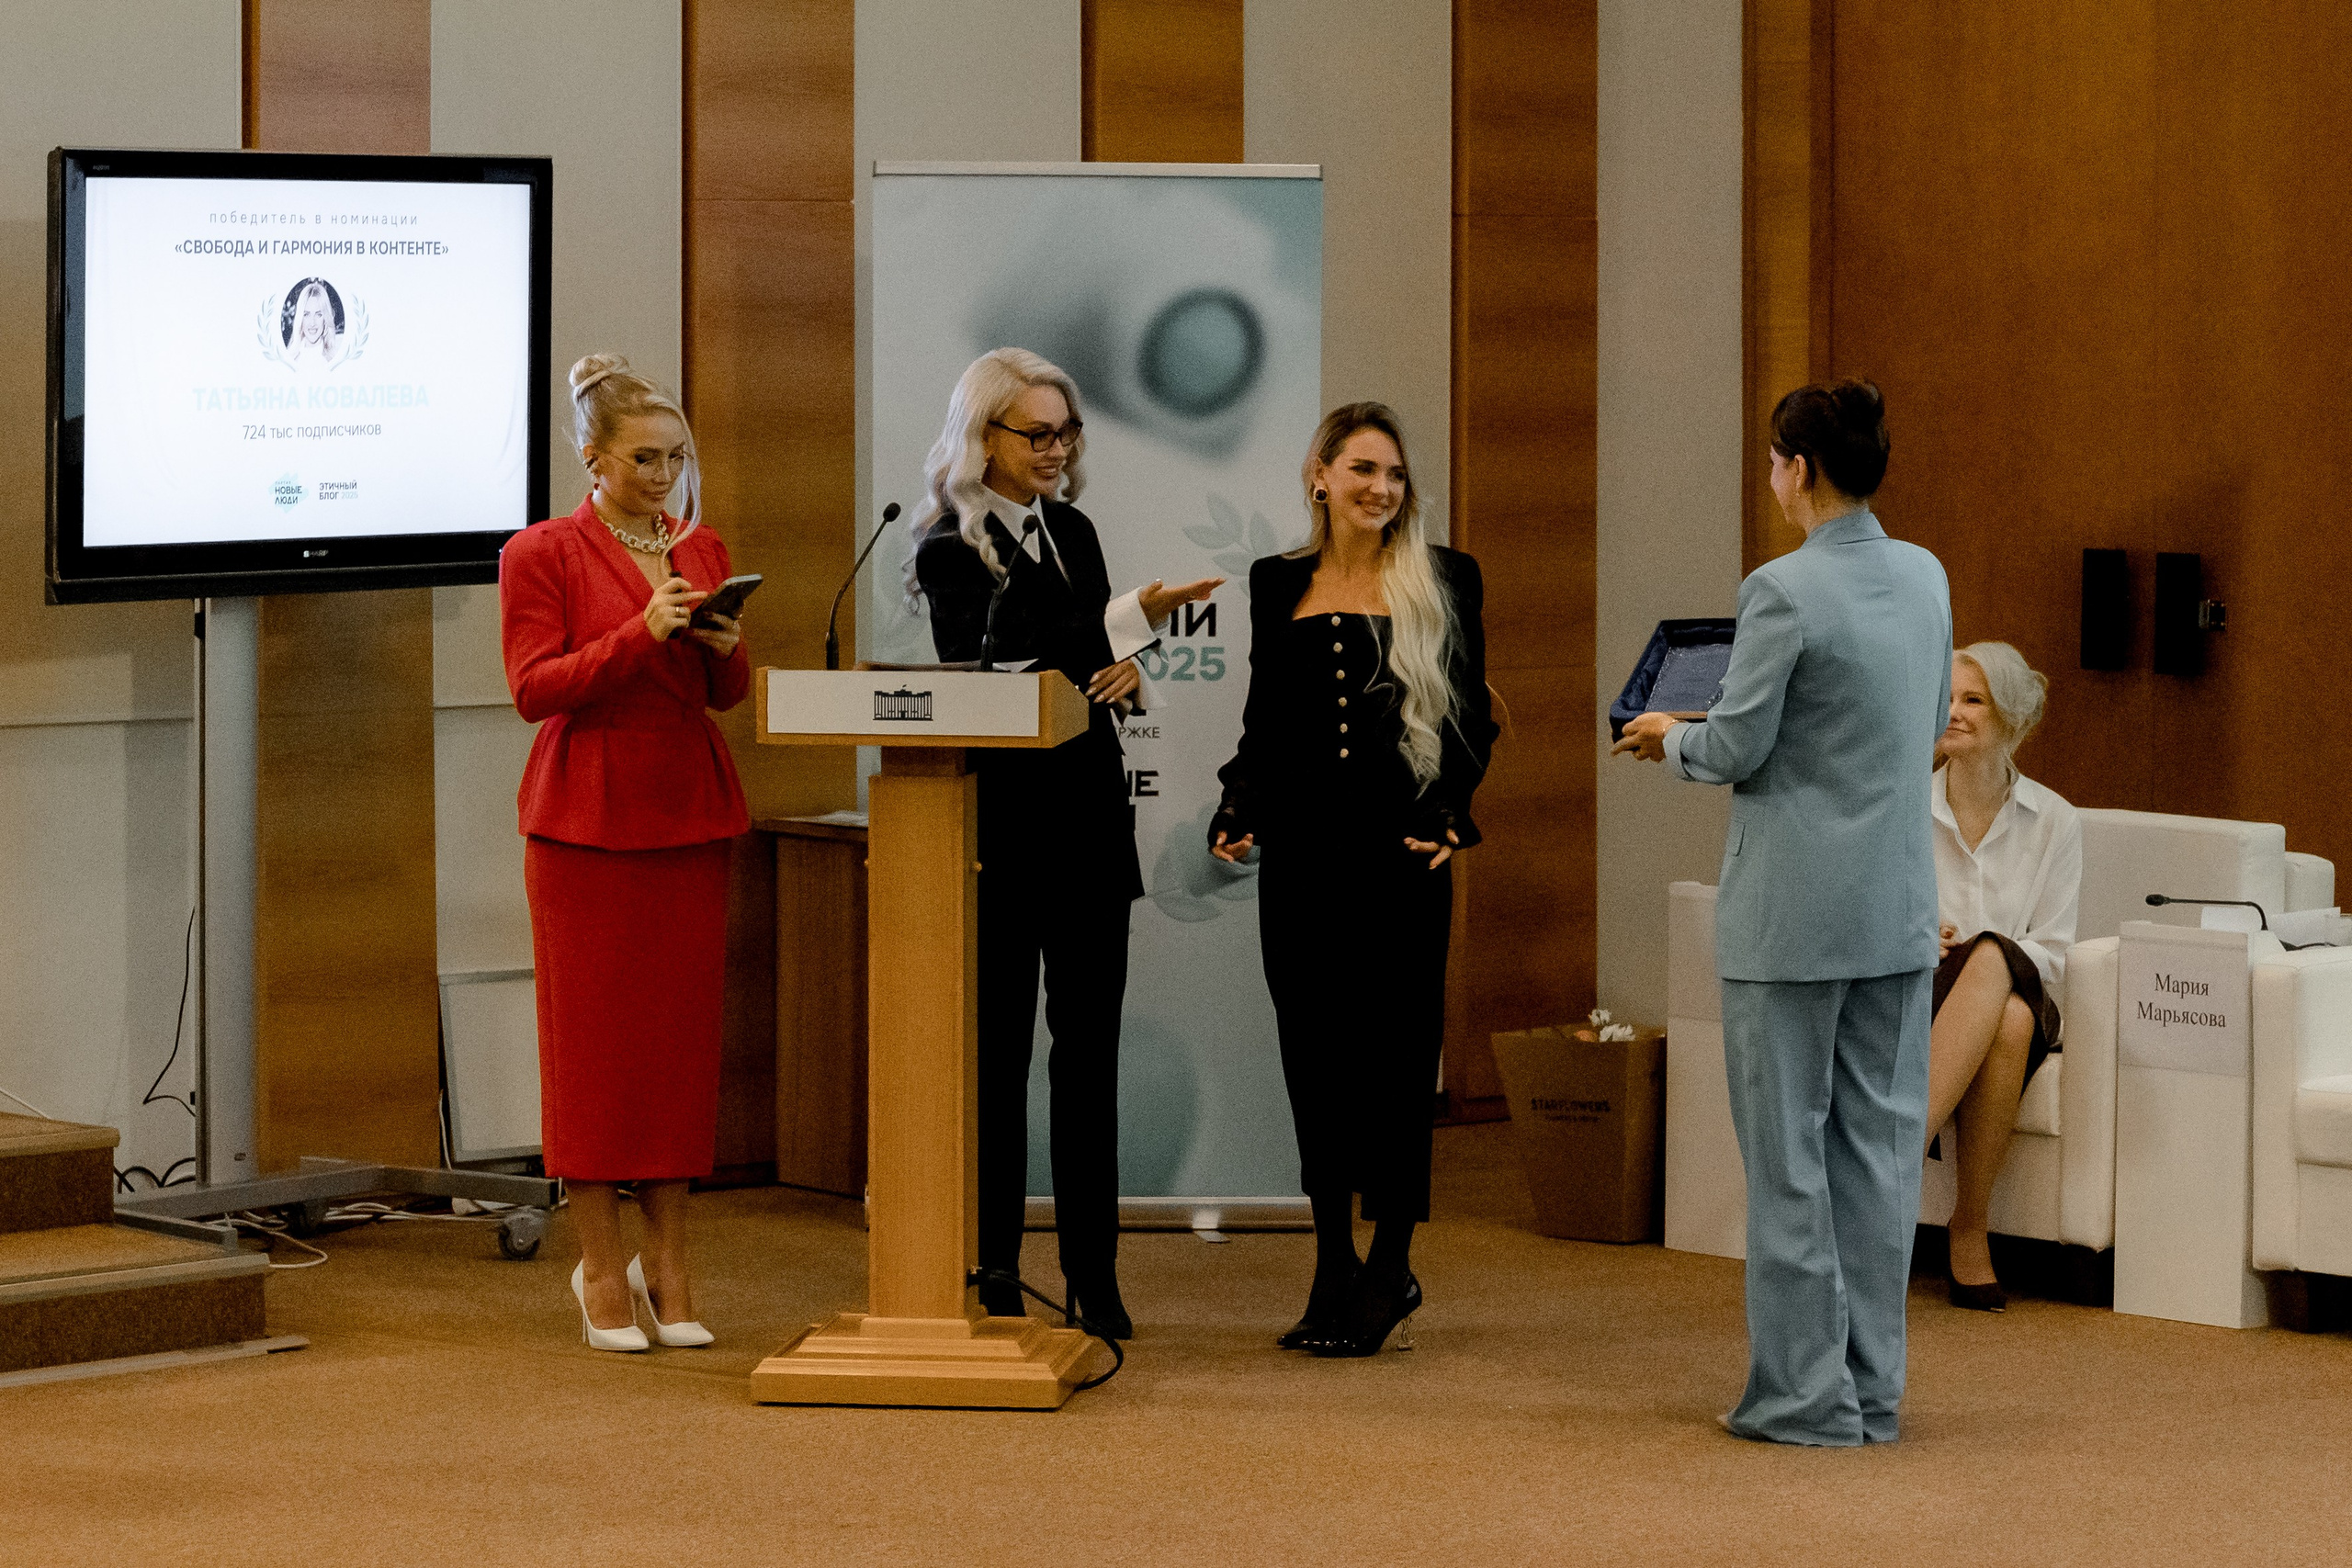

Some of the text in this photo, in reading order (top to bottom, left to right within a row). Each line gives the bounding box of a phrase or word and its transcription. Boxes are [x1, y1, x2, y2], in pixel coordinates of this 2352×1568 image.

[209, 210, 417, 227] победитель в номинации
[175, 240, 449, 257] «СВОБОДА И ГАРМОНИЯ В КОНТЕНТЕ»
[192, 384, 430, 412] ТАТЬЯНА КОВАЛЕВА
[243, 425, 266, 440] 724
[275, 485, 302, 495] НОВЫЕ
[319, 479, 357, 491] ЭТИЧНЫЙ
[275, 496, 299, 505] ЛЮДИ
[319, 491, 339, 501] БЛОГ
[1141, 647, 1227, 682] 025
[1118, 727, 1160, 739] РЖКЕ
[2154, 973, 2210, 999] Мария
[2137, 1000, 2226, 1028] Марьясова
